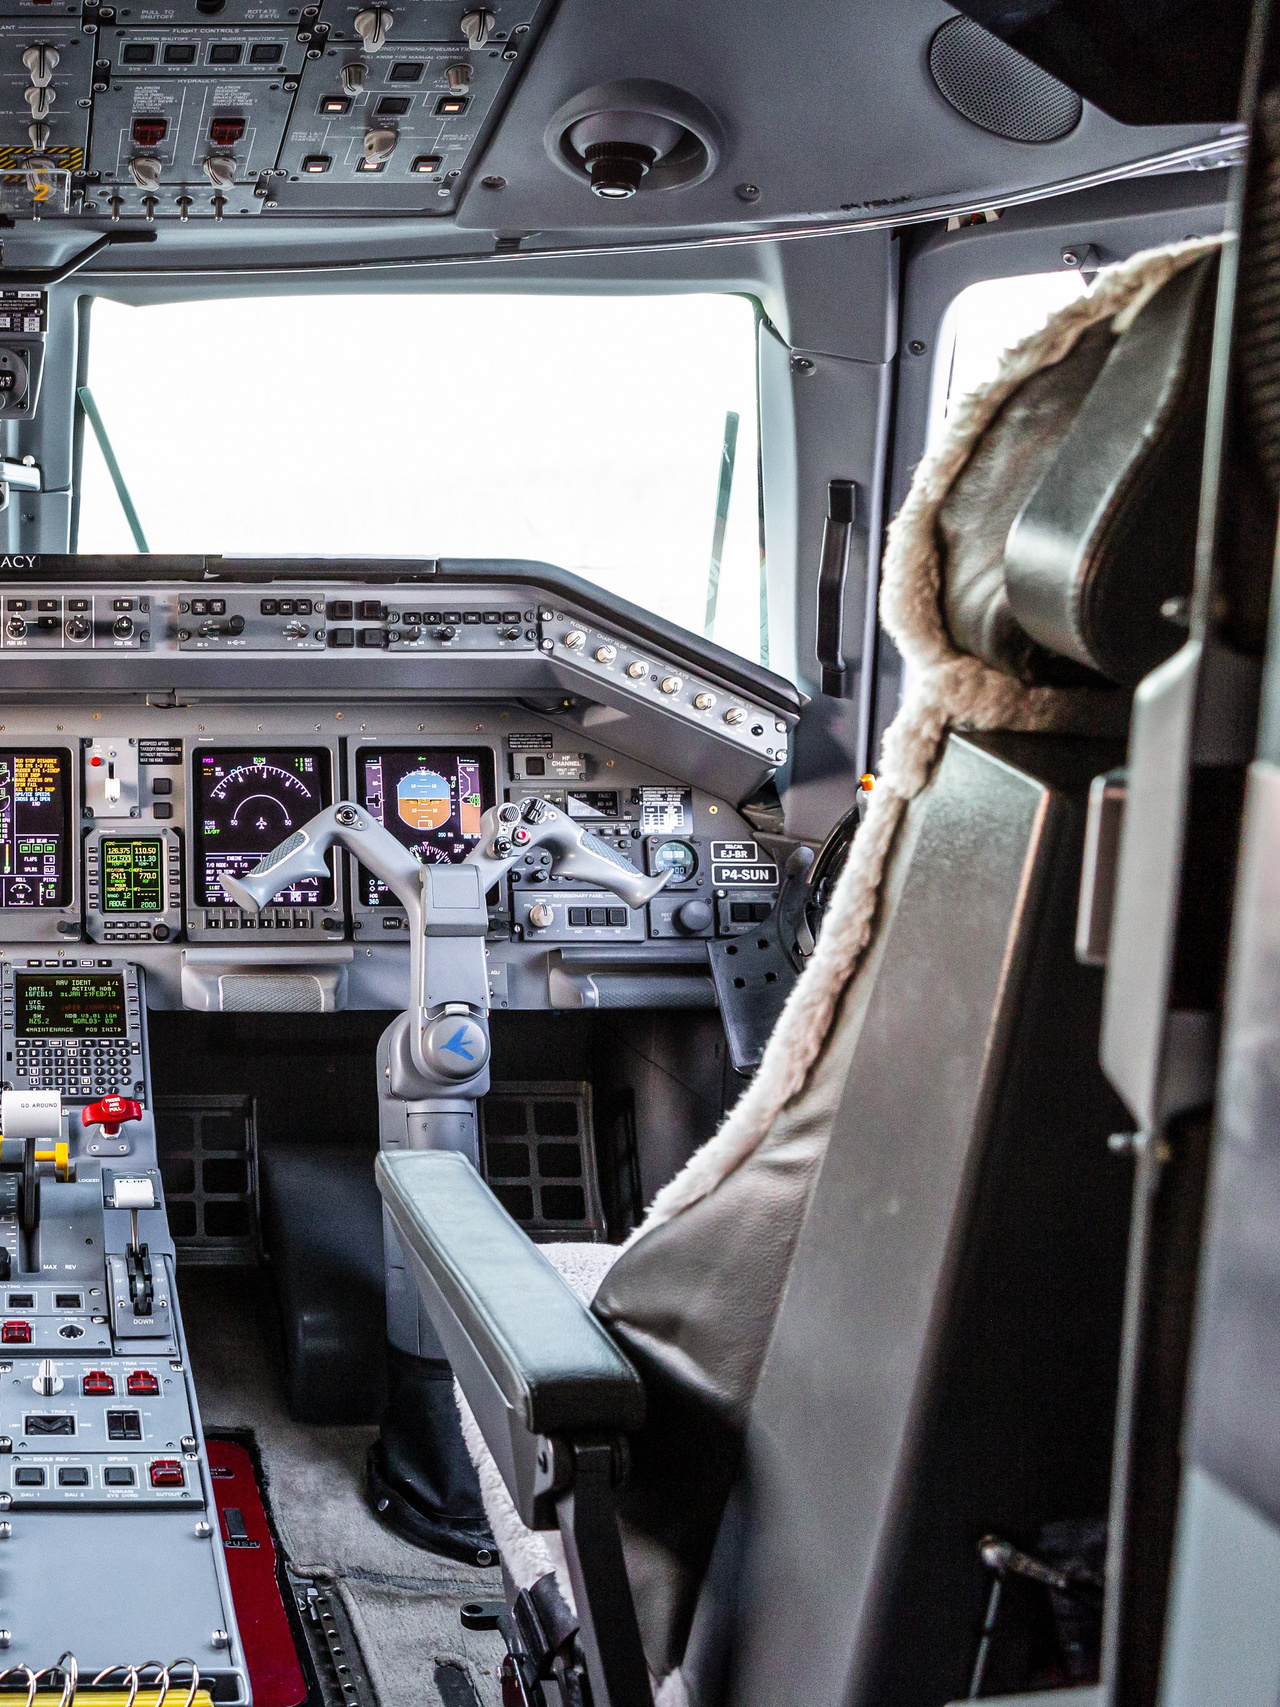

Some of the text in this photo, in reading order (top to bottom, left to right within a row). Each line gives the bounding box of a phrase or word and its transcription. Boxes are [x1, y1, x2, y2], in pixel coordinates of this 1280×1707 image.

[34, 185, 48, 200] 2
[570, 621, 592, 633] FLOODLT
[665, 666, 690, 680] DISPLAYS
[722, 869, 769, 880] P4-SUN
